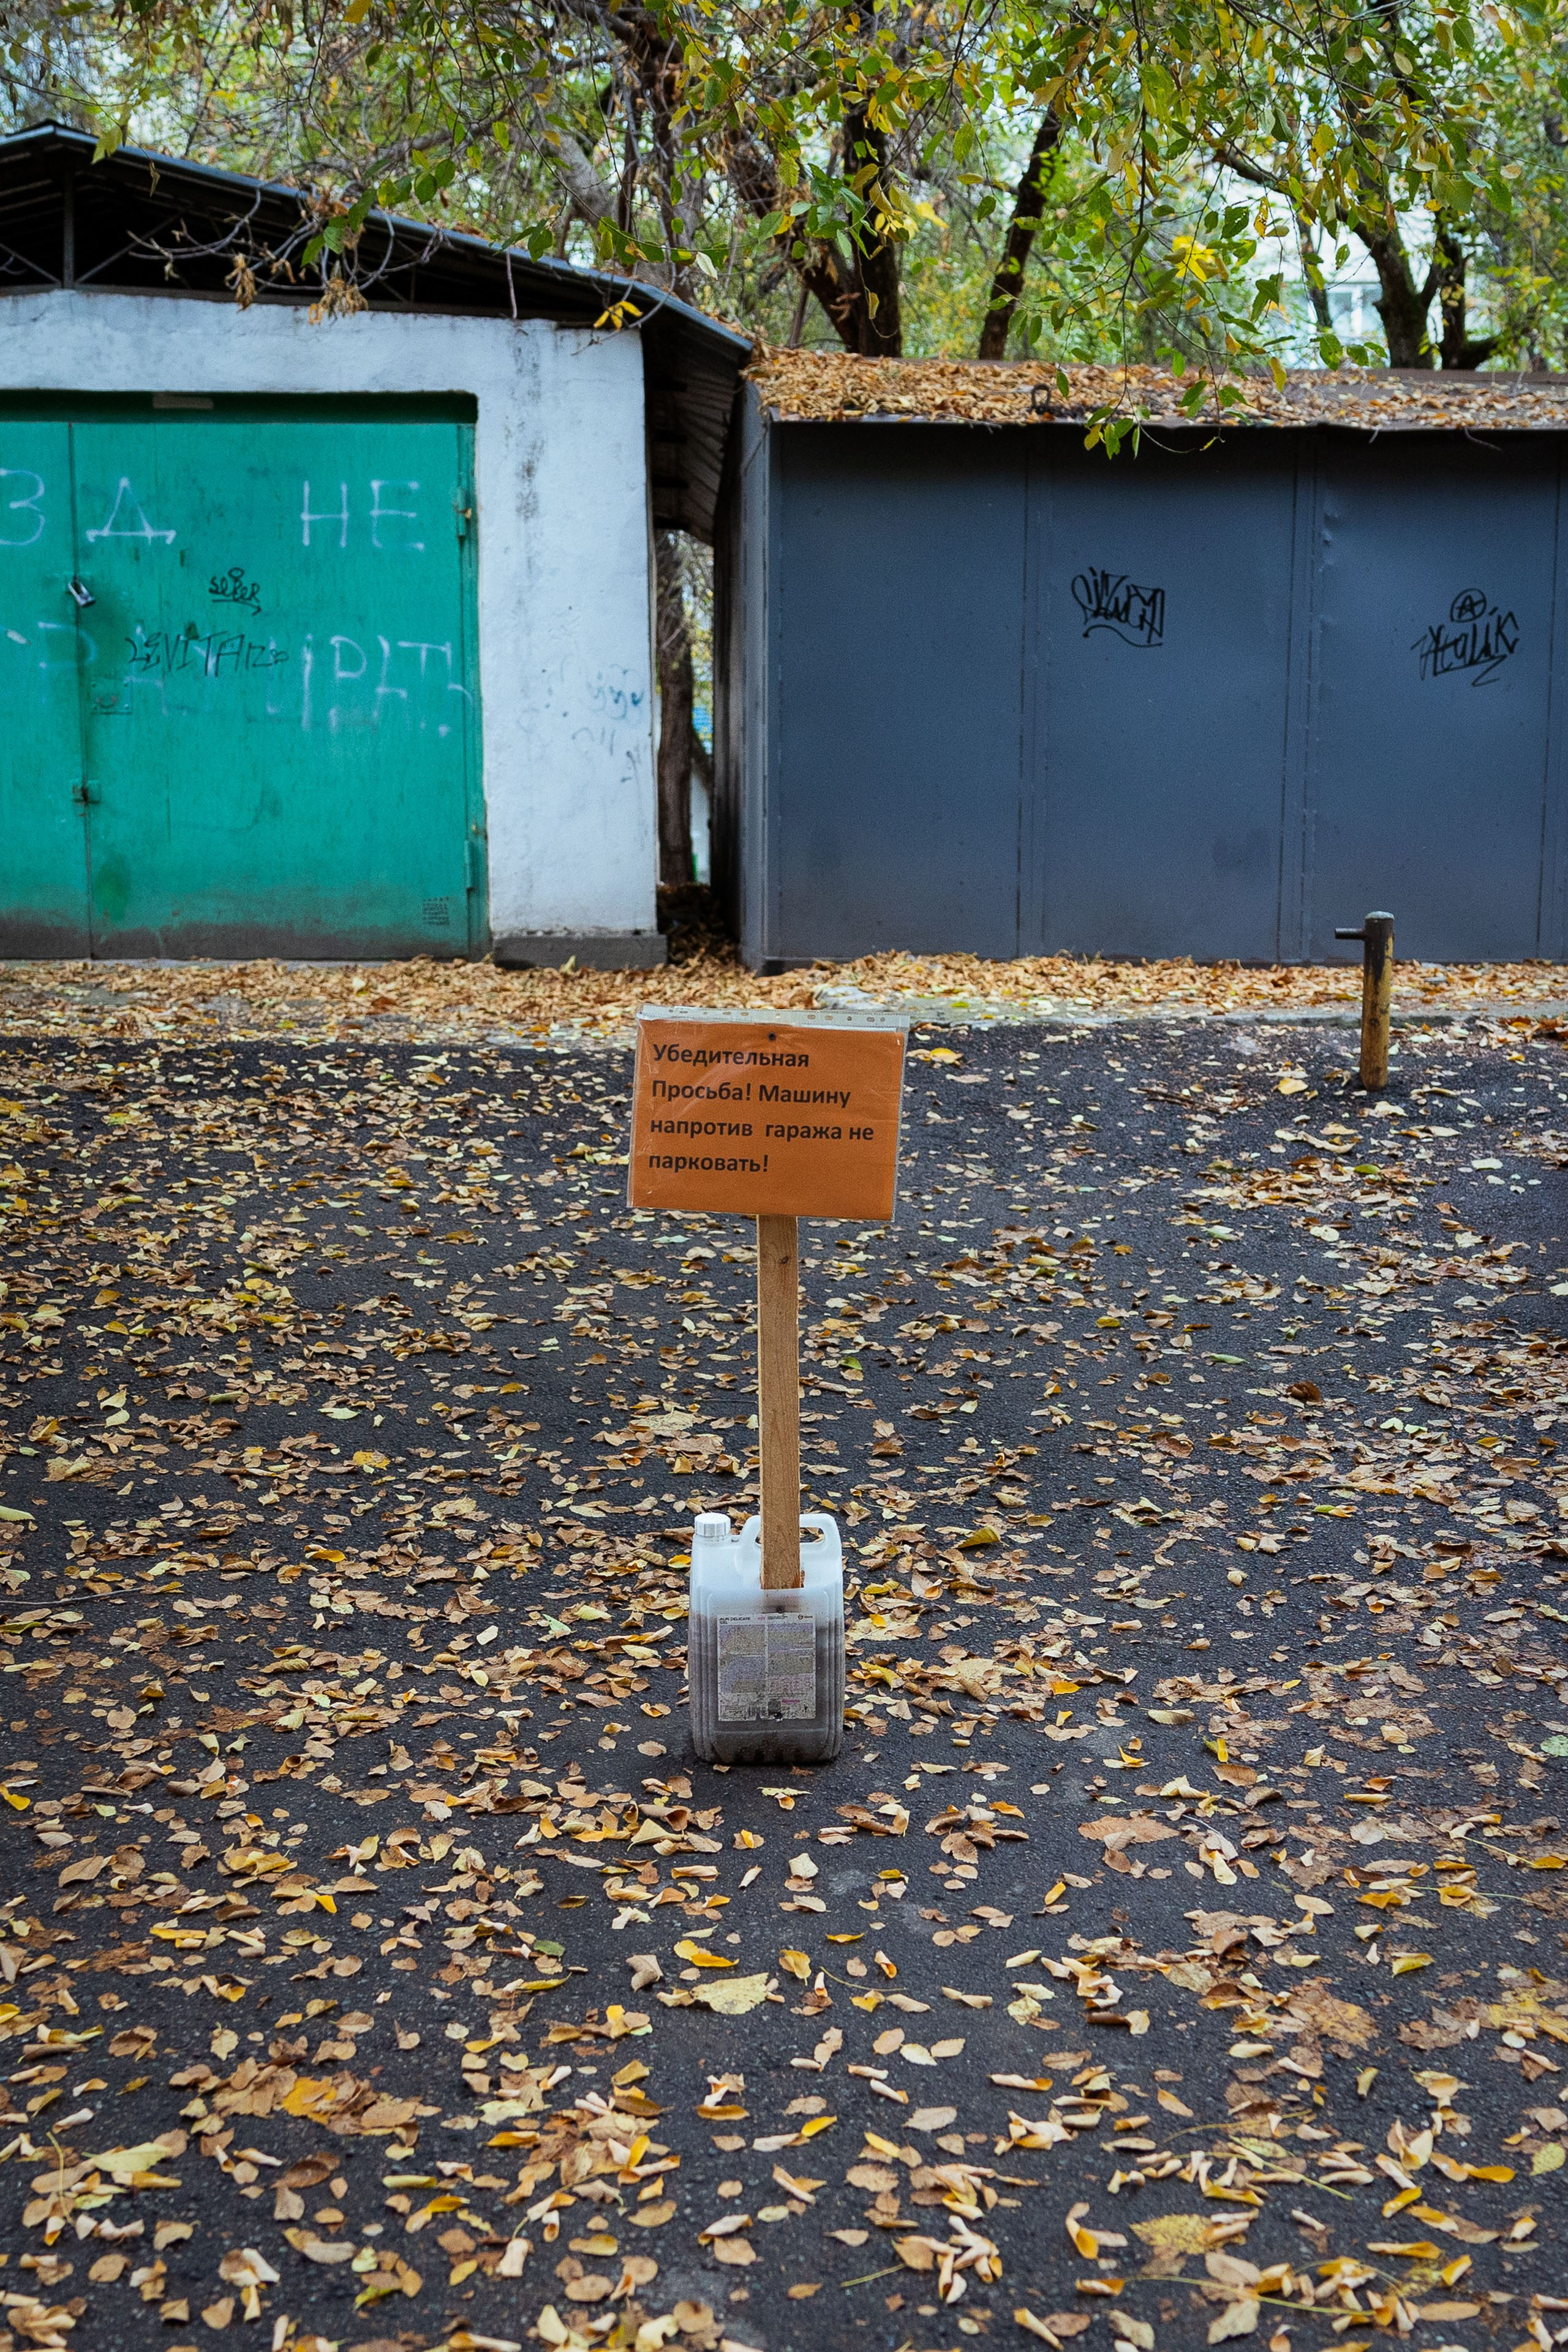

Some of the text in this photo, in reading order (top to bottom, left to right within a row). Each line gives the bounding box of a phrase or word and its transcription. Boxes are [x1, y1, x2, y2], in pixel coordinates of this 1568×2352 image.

[653, 1044, 810, 1068] Убедительная
[652, 1080, 851, 1108] Просьба! Машину
[650, 1119, 874, 1142] напротив гаража не
[649, 1154, 769, 1172] парковать!
